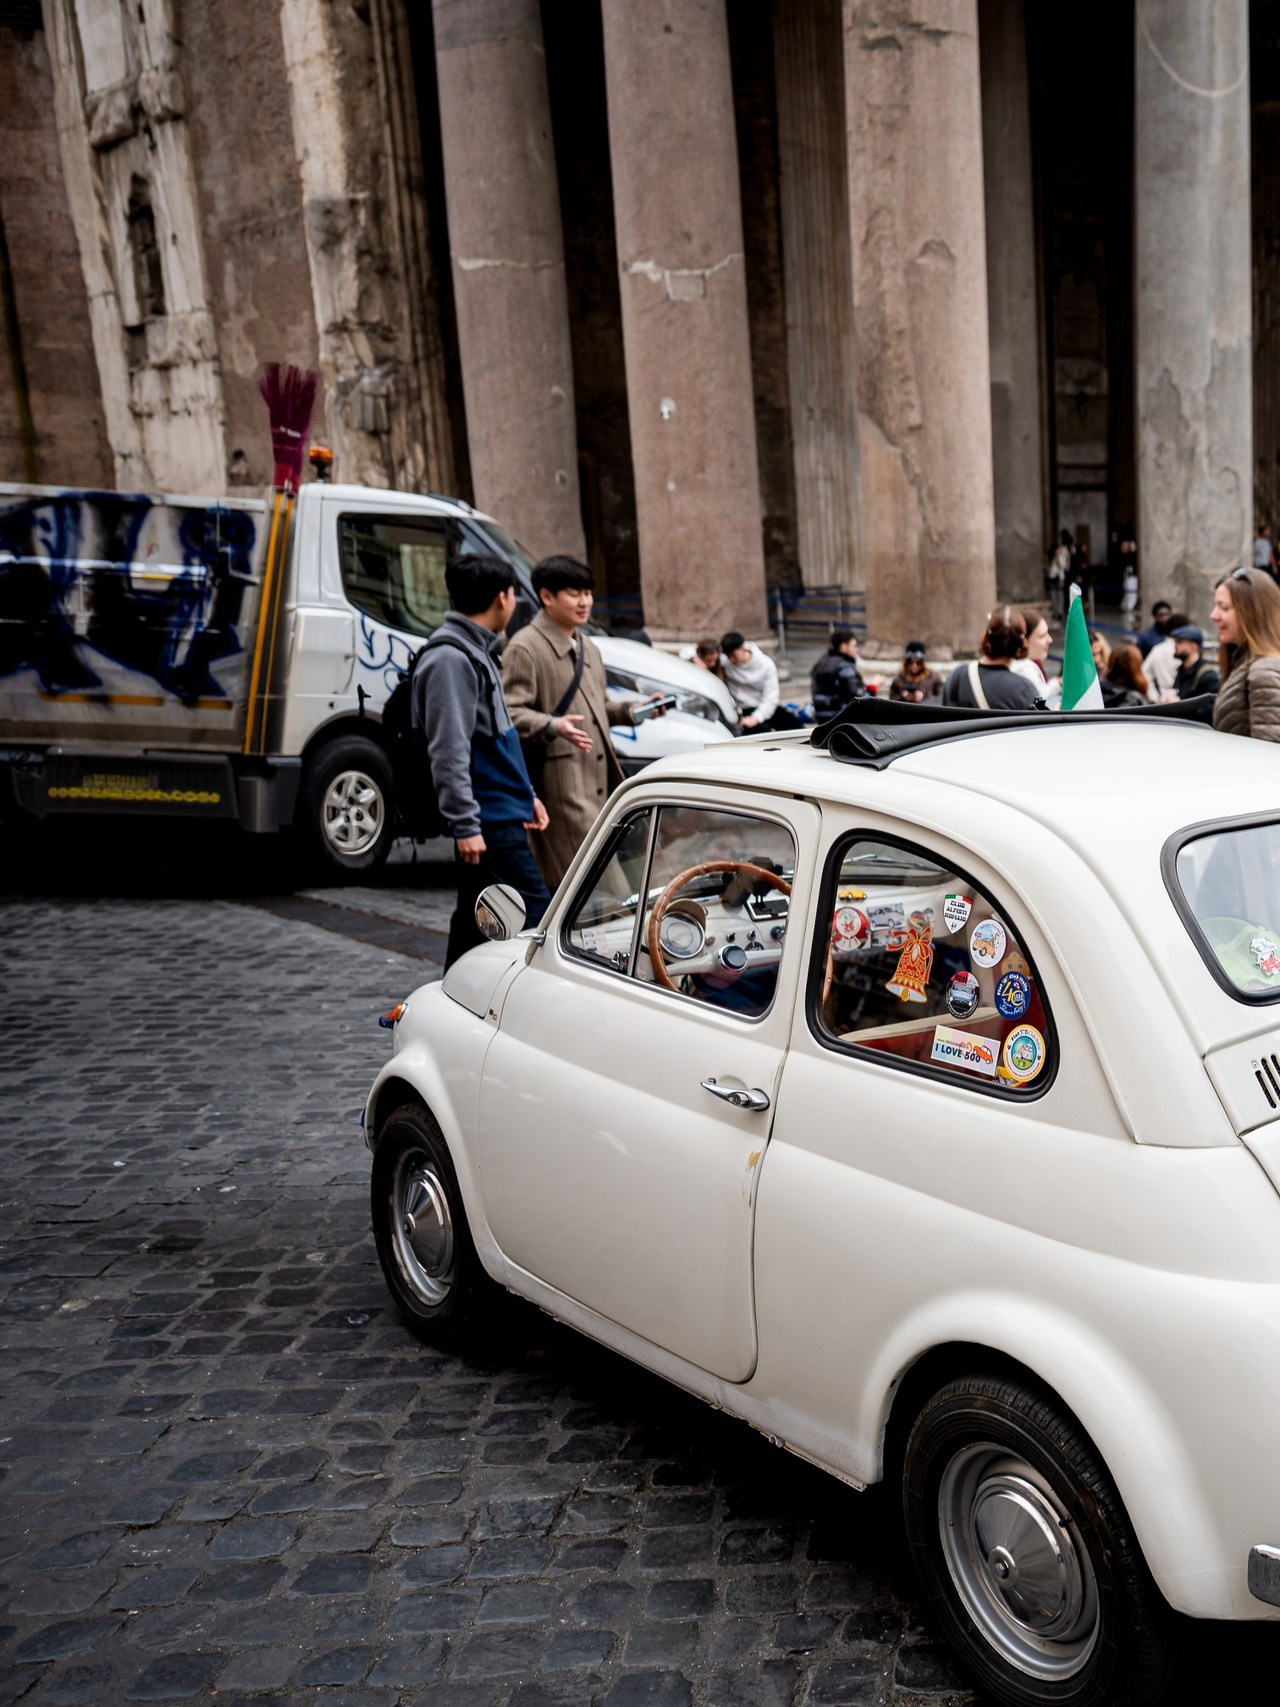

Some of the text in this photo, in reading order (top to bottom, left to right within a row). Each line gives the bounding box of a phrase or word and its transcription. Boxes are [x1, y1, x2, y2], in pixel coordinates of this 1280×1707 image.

[935, 1043, 939, 1052] I
[941, 1044, 962, 1058] LOVE
[964, 1051, 981, 1063] 500
